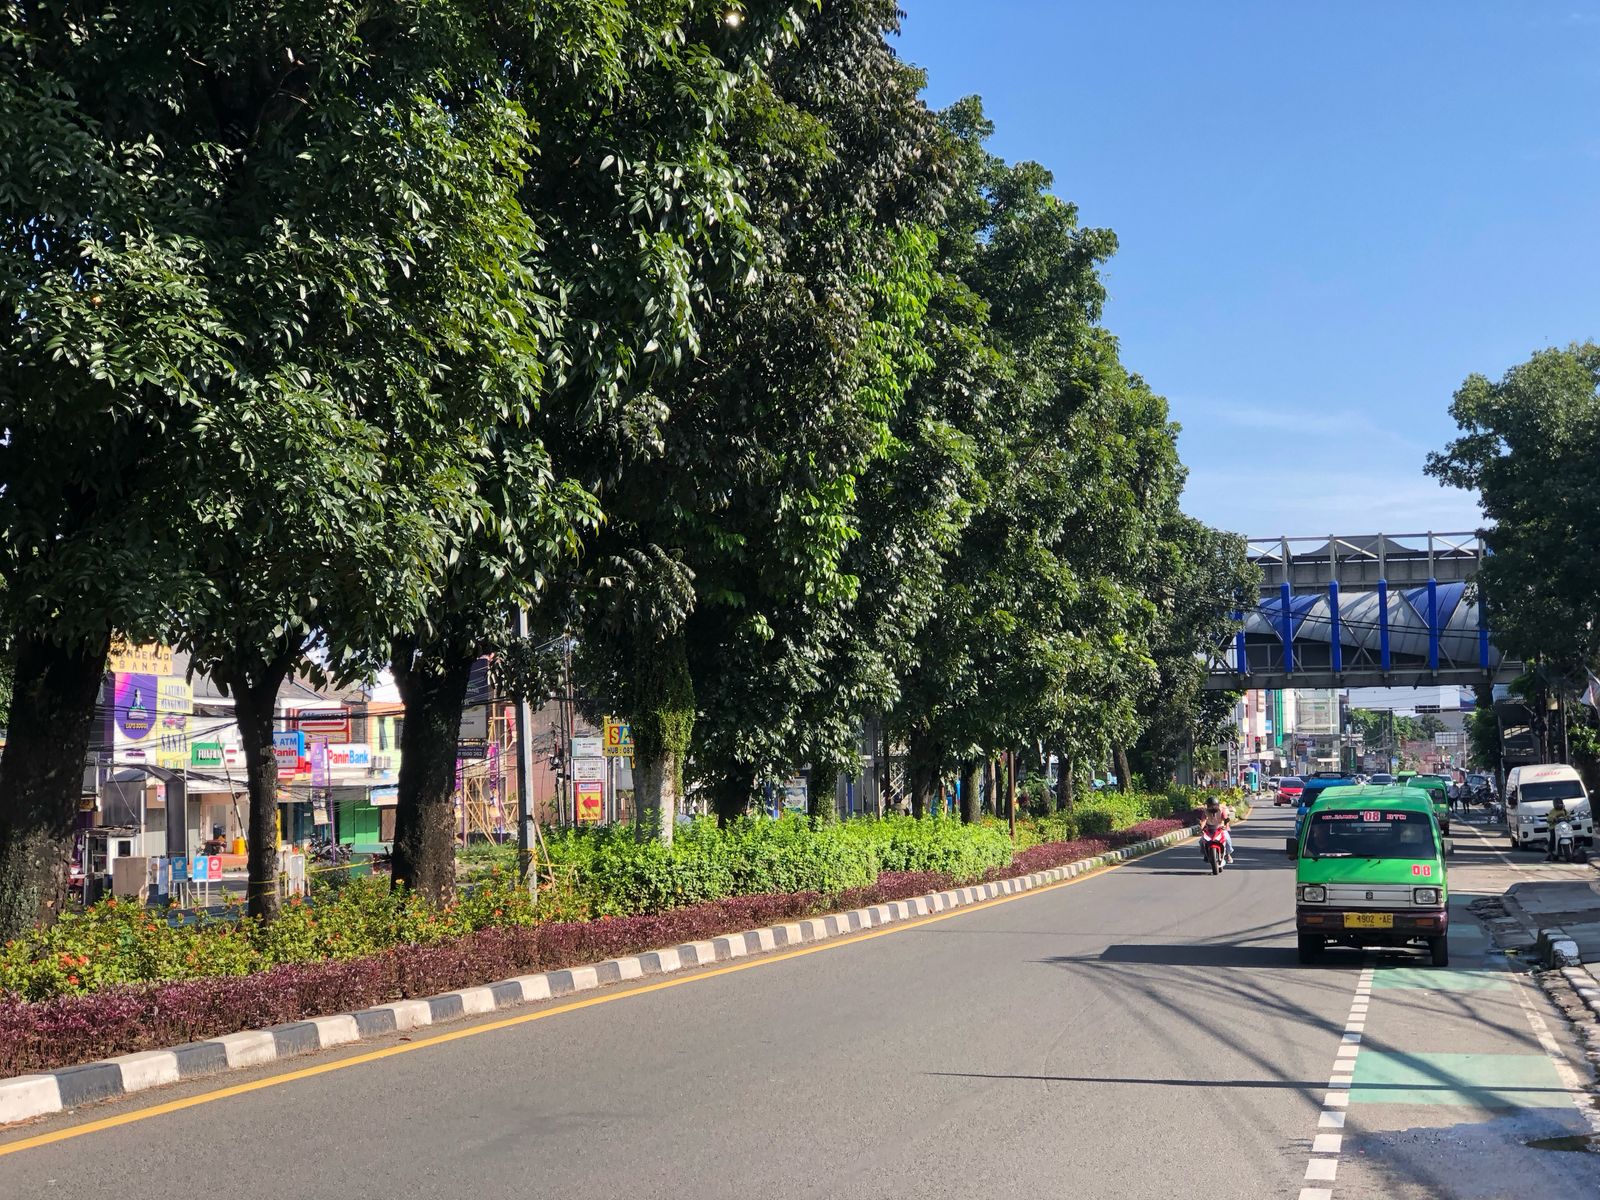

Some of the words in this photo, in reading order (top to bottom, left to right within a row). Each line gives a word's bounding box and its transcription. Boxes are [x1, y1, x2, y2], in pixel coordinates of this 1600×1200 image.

[280, 737, 297, 746] ATM
[610, 727, 630, 744] SA
[161, 733, 187, 752] SANTA
[328, 749, 368, 764] PaninBank
[1364, 811, 1380, 821] 08
[1412, 864, 1431, 876] 08
[1345, 914, 1350, 923] F
[1382, 914, 1391, 924] AE
